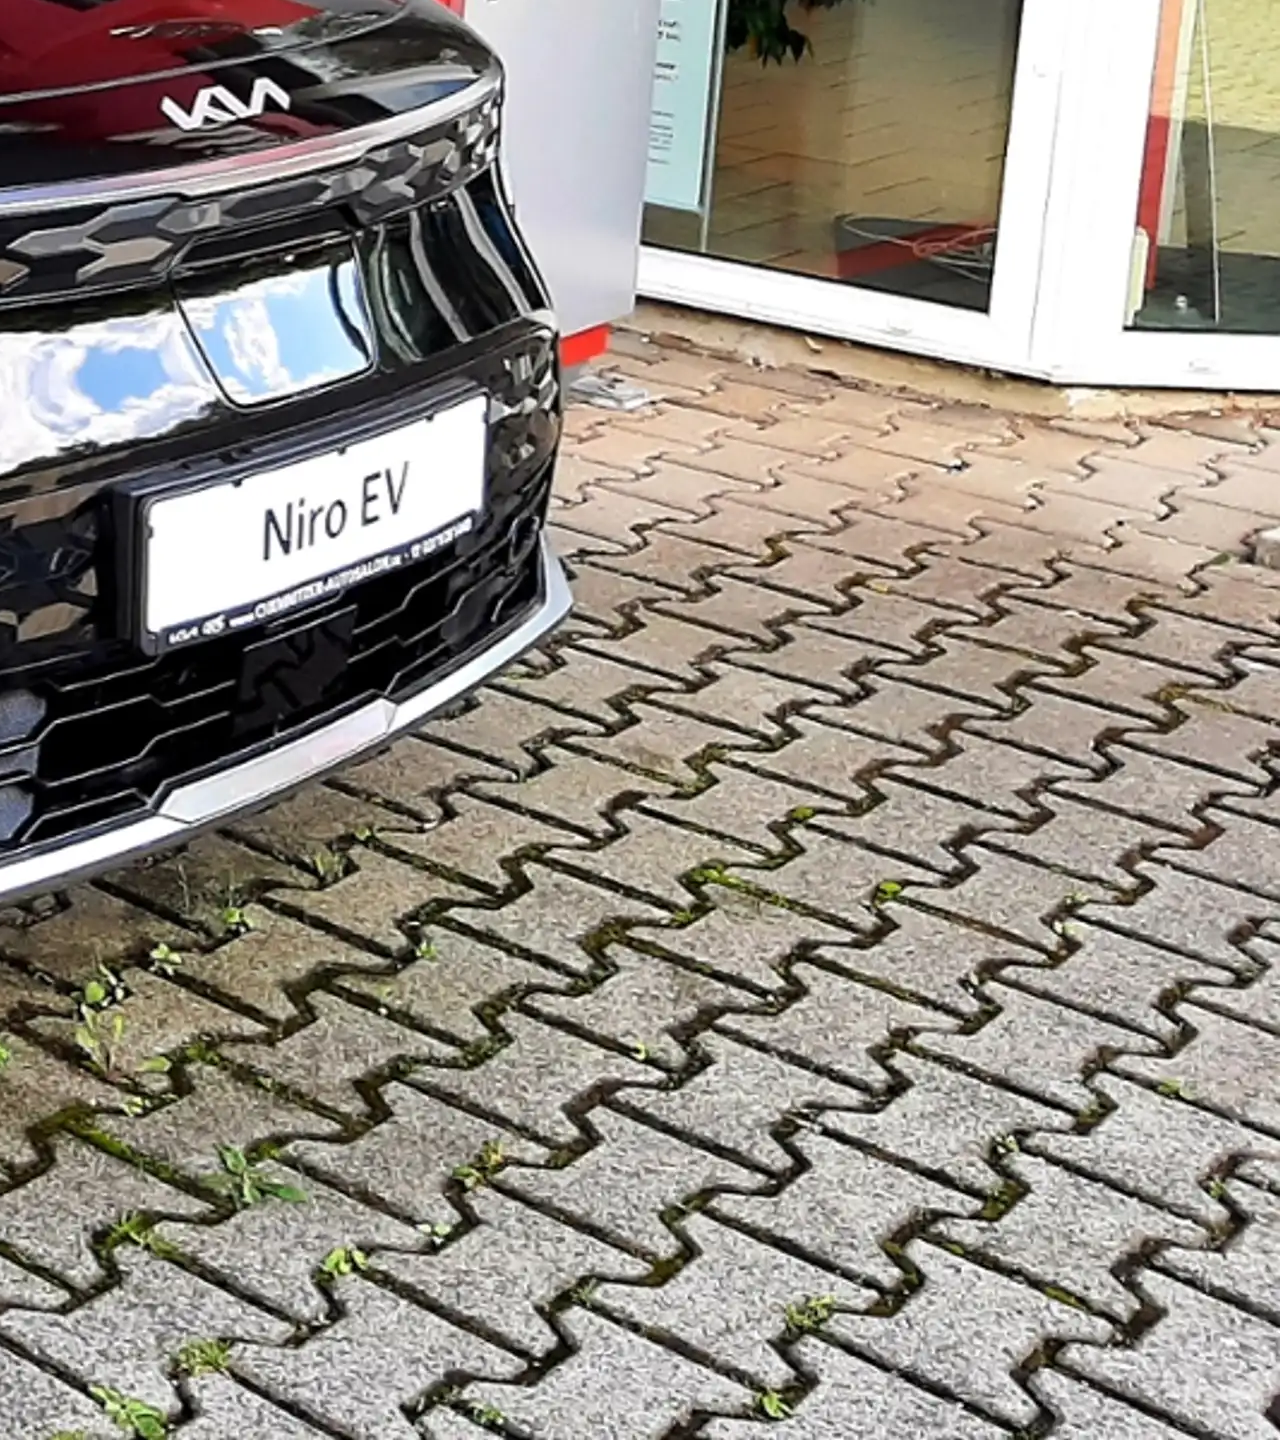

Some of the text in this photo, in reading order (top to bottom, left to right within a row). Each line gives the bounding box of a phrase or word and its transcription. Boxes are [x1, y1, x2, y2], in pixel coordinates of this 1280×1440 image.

[161, 76, 290, 130] KIA
[262, 497, 348, 562] Niro
[360, 461, 410, 526] EV
